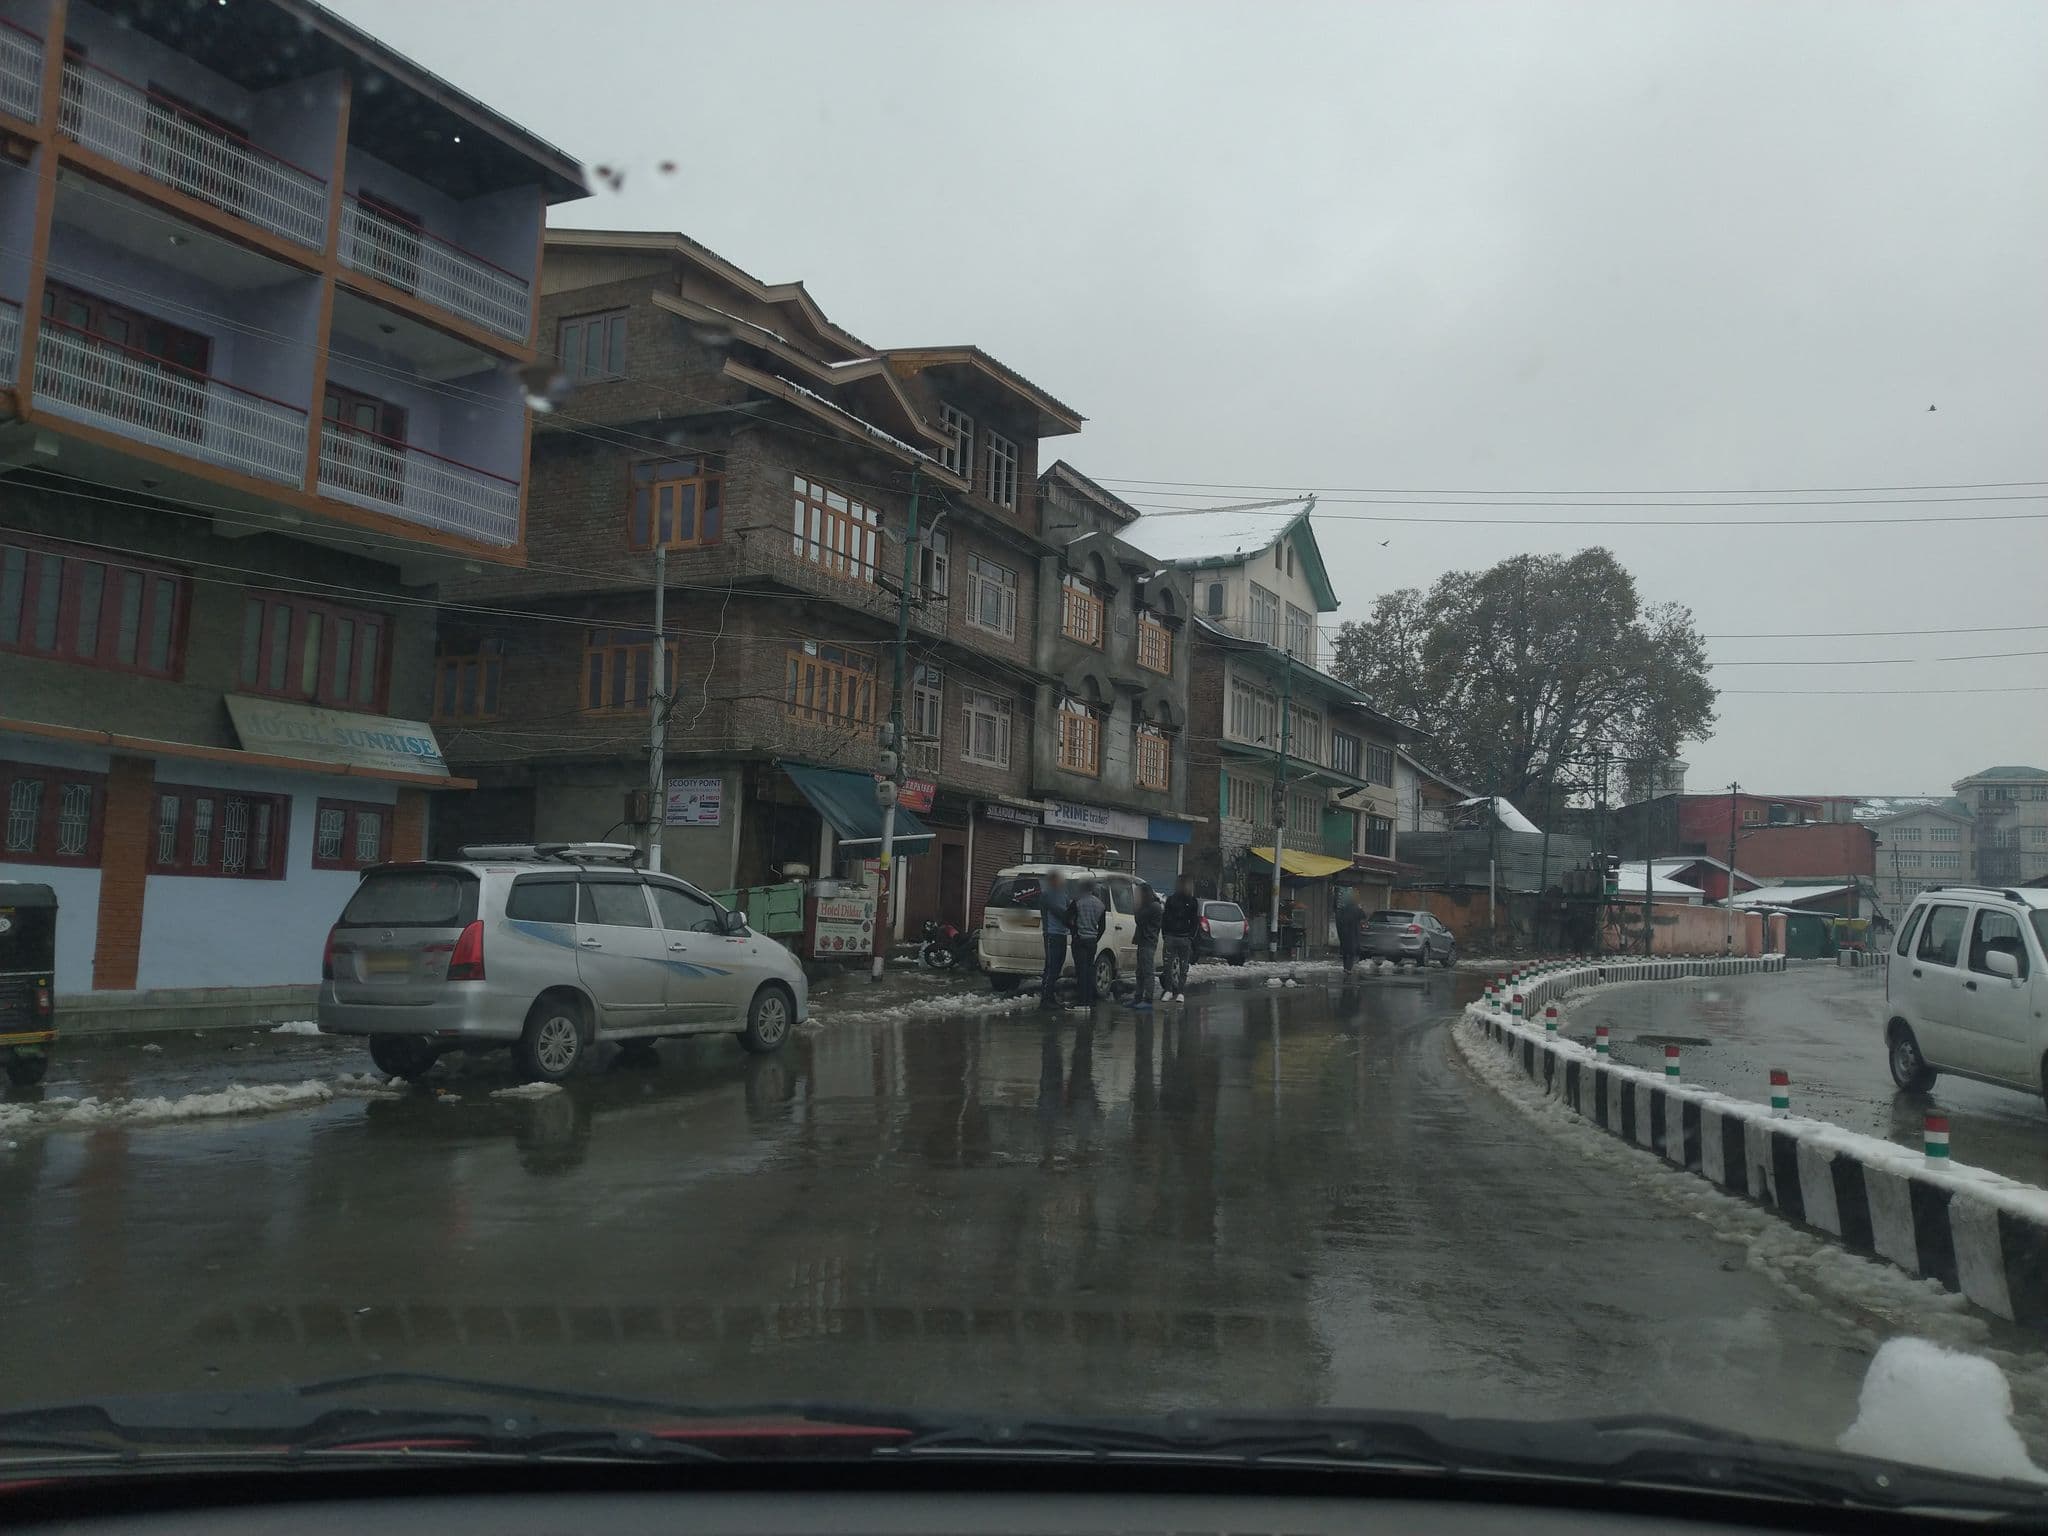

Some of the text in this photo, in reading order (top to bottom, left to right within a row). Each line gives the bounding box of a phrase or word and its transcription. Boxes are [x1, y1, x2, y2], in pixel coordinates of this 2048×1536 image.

[334, 728, 438, 757] SUNRISE
[669, 779, 720, 787] SCOOTY POINT
[1055, 804, 1089, 822] PRIME
[820, 903, 840, 917] Hotel
